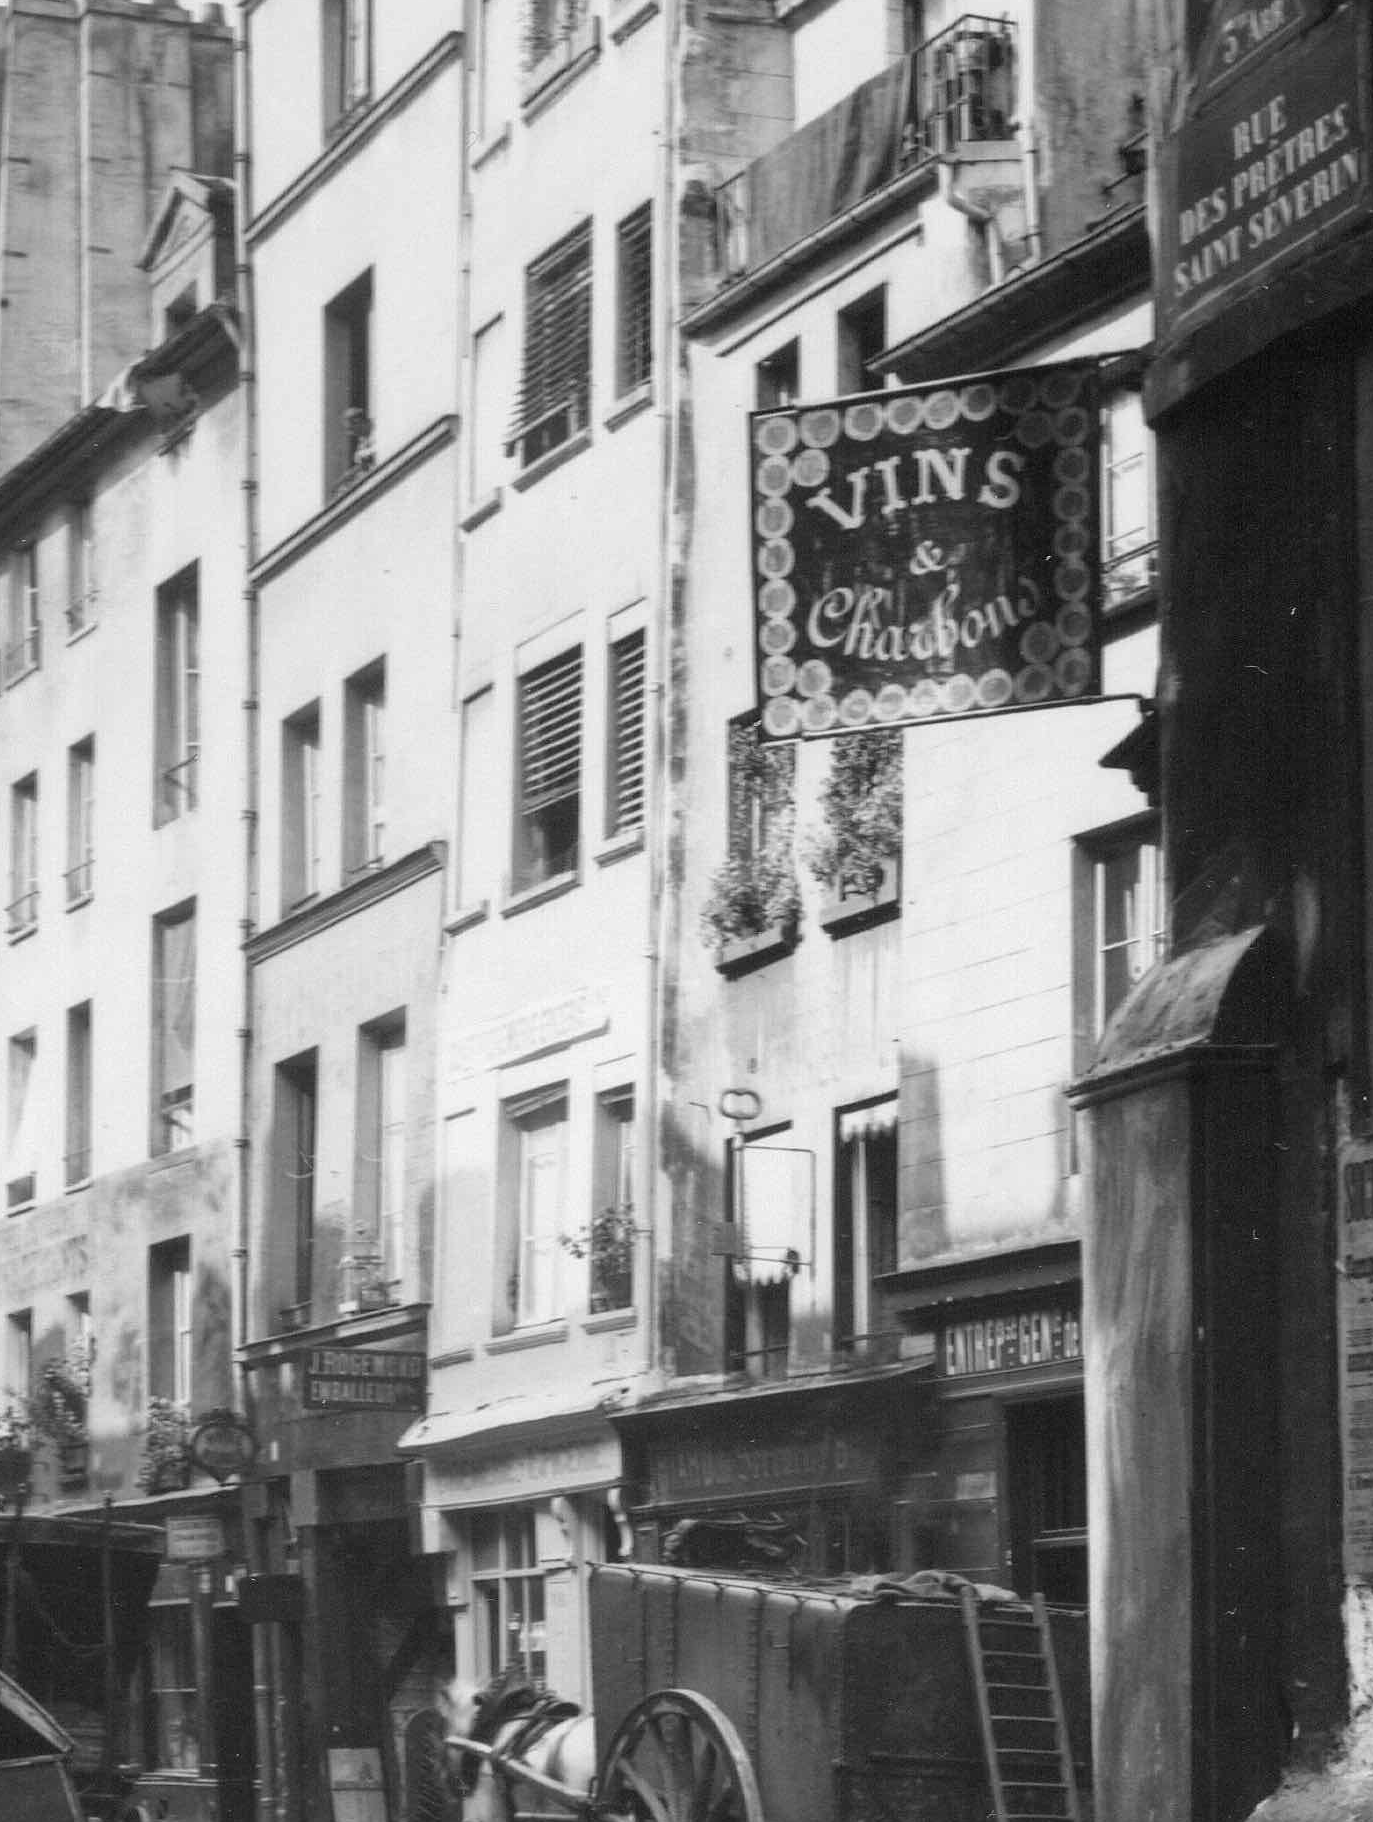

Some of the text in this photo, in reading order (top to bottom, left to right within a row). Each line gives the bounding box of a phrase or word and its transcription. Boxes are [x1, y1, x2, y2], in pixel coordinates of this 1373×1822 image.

[1232, 93, 1287, 161] RUE
[1178, 186, 1229, 246] DES
[1172, 225, 1244, 298] SAINT
[804, 447, 1026, 531] VINS
[909, 539, 948, 576] &
